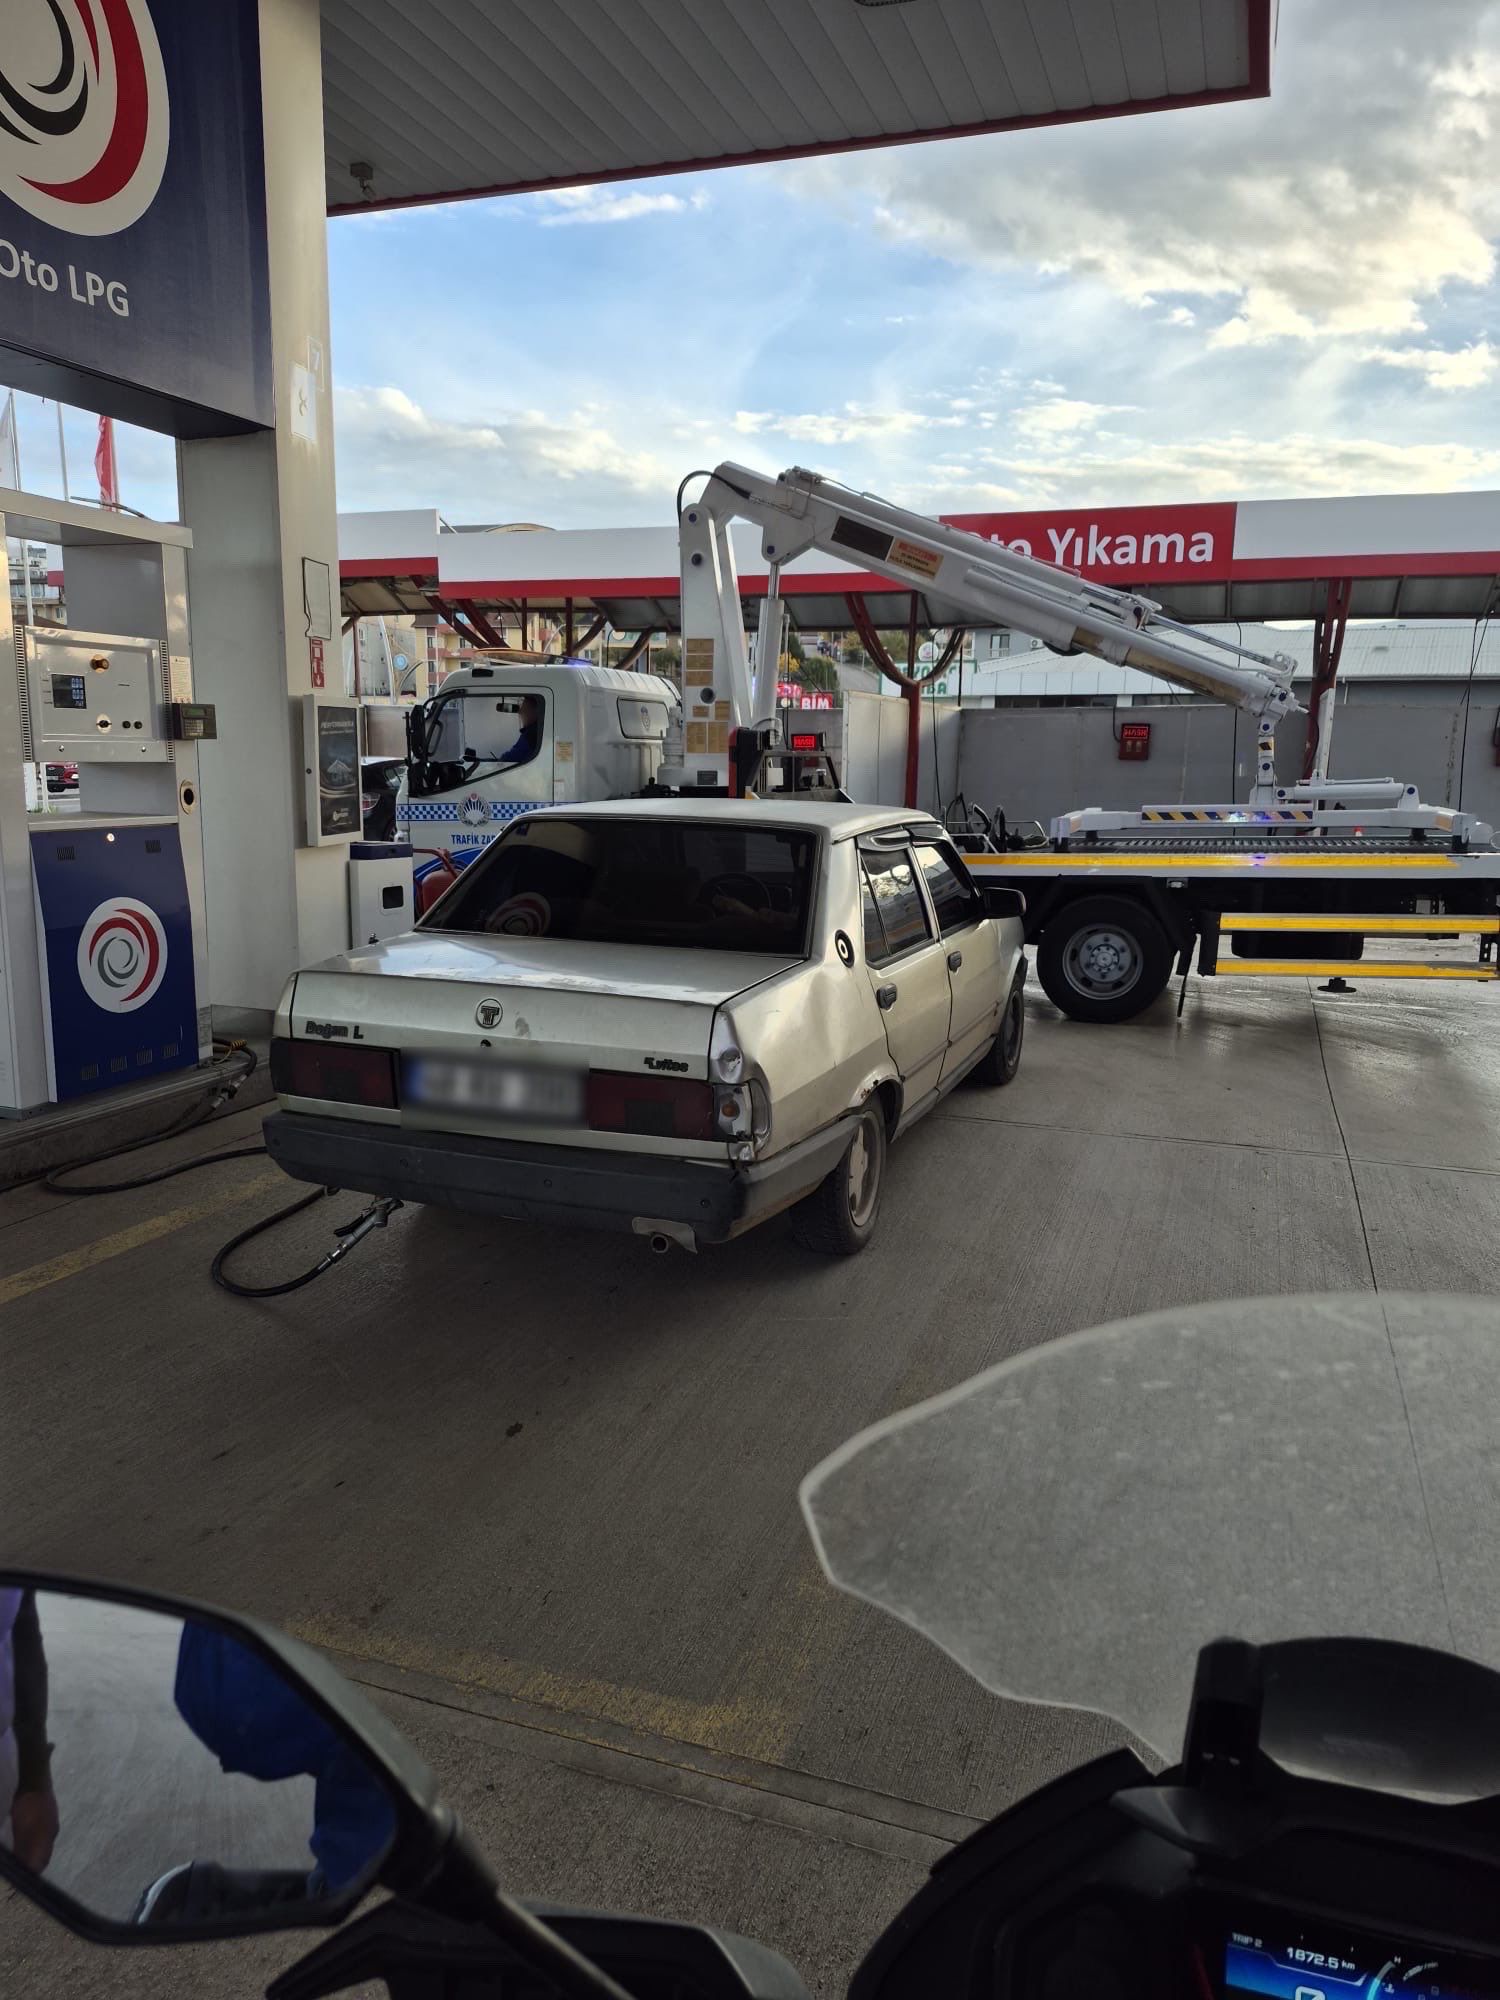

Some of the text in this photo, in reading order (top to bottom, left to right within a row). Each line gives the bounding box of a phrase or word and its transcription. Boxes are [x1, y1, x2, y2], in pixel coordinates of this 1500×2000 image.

[0, 238, 130, 317] Oto LPG
[1046, 524, 1215, 567] Yıkama
[451, 832, 480, 845] TRAFİK
[353, 1025, 364, 1040] L
[1341, 1959, 1356, 1970] km
